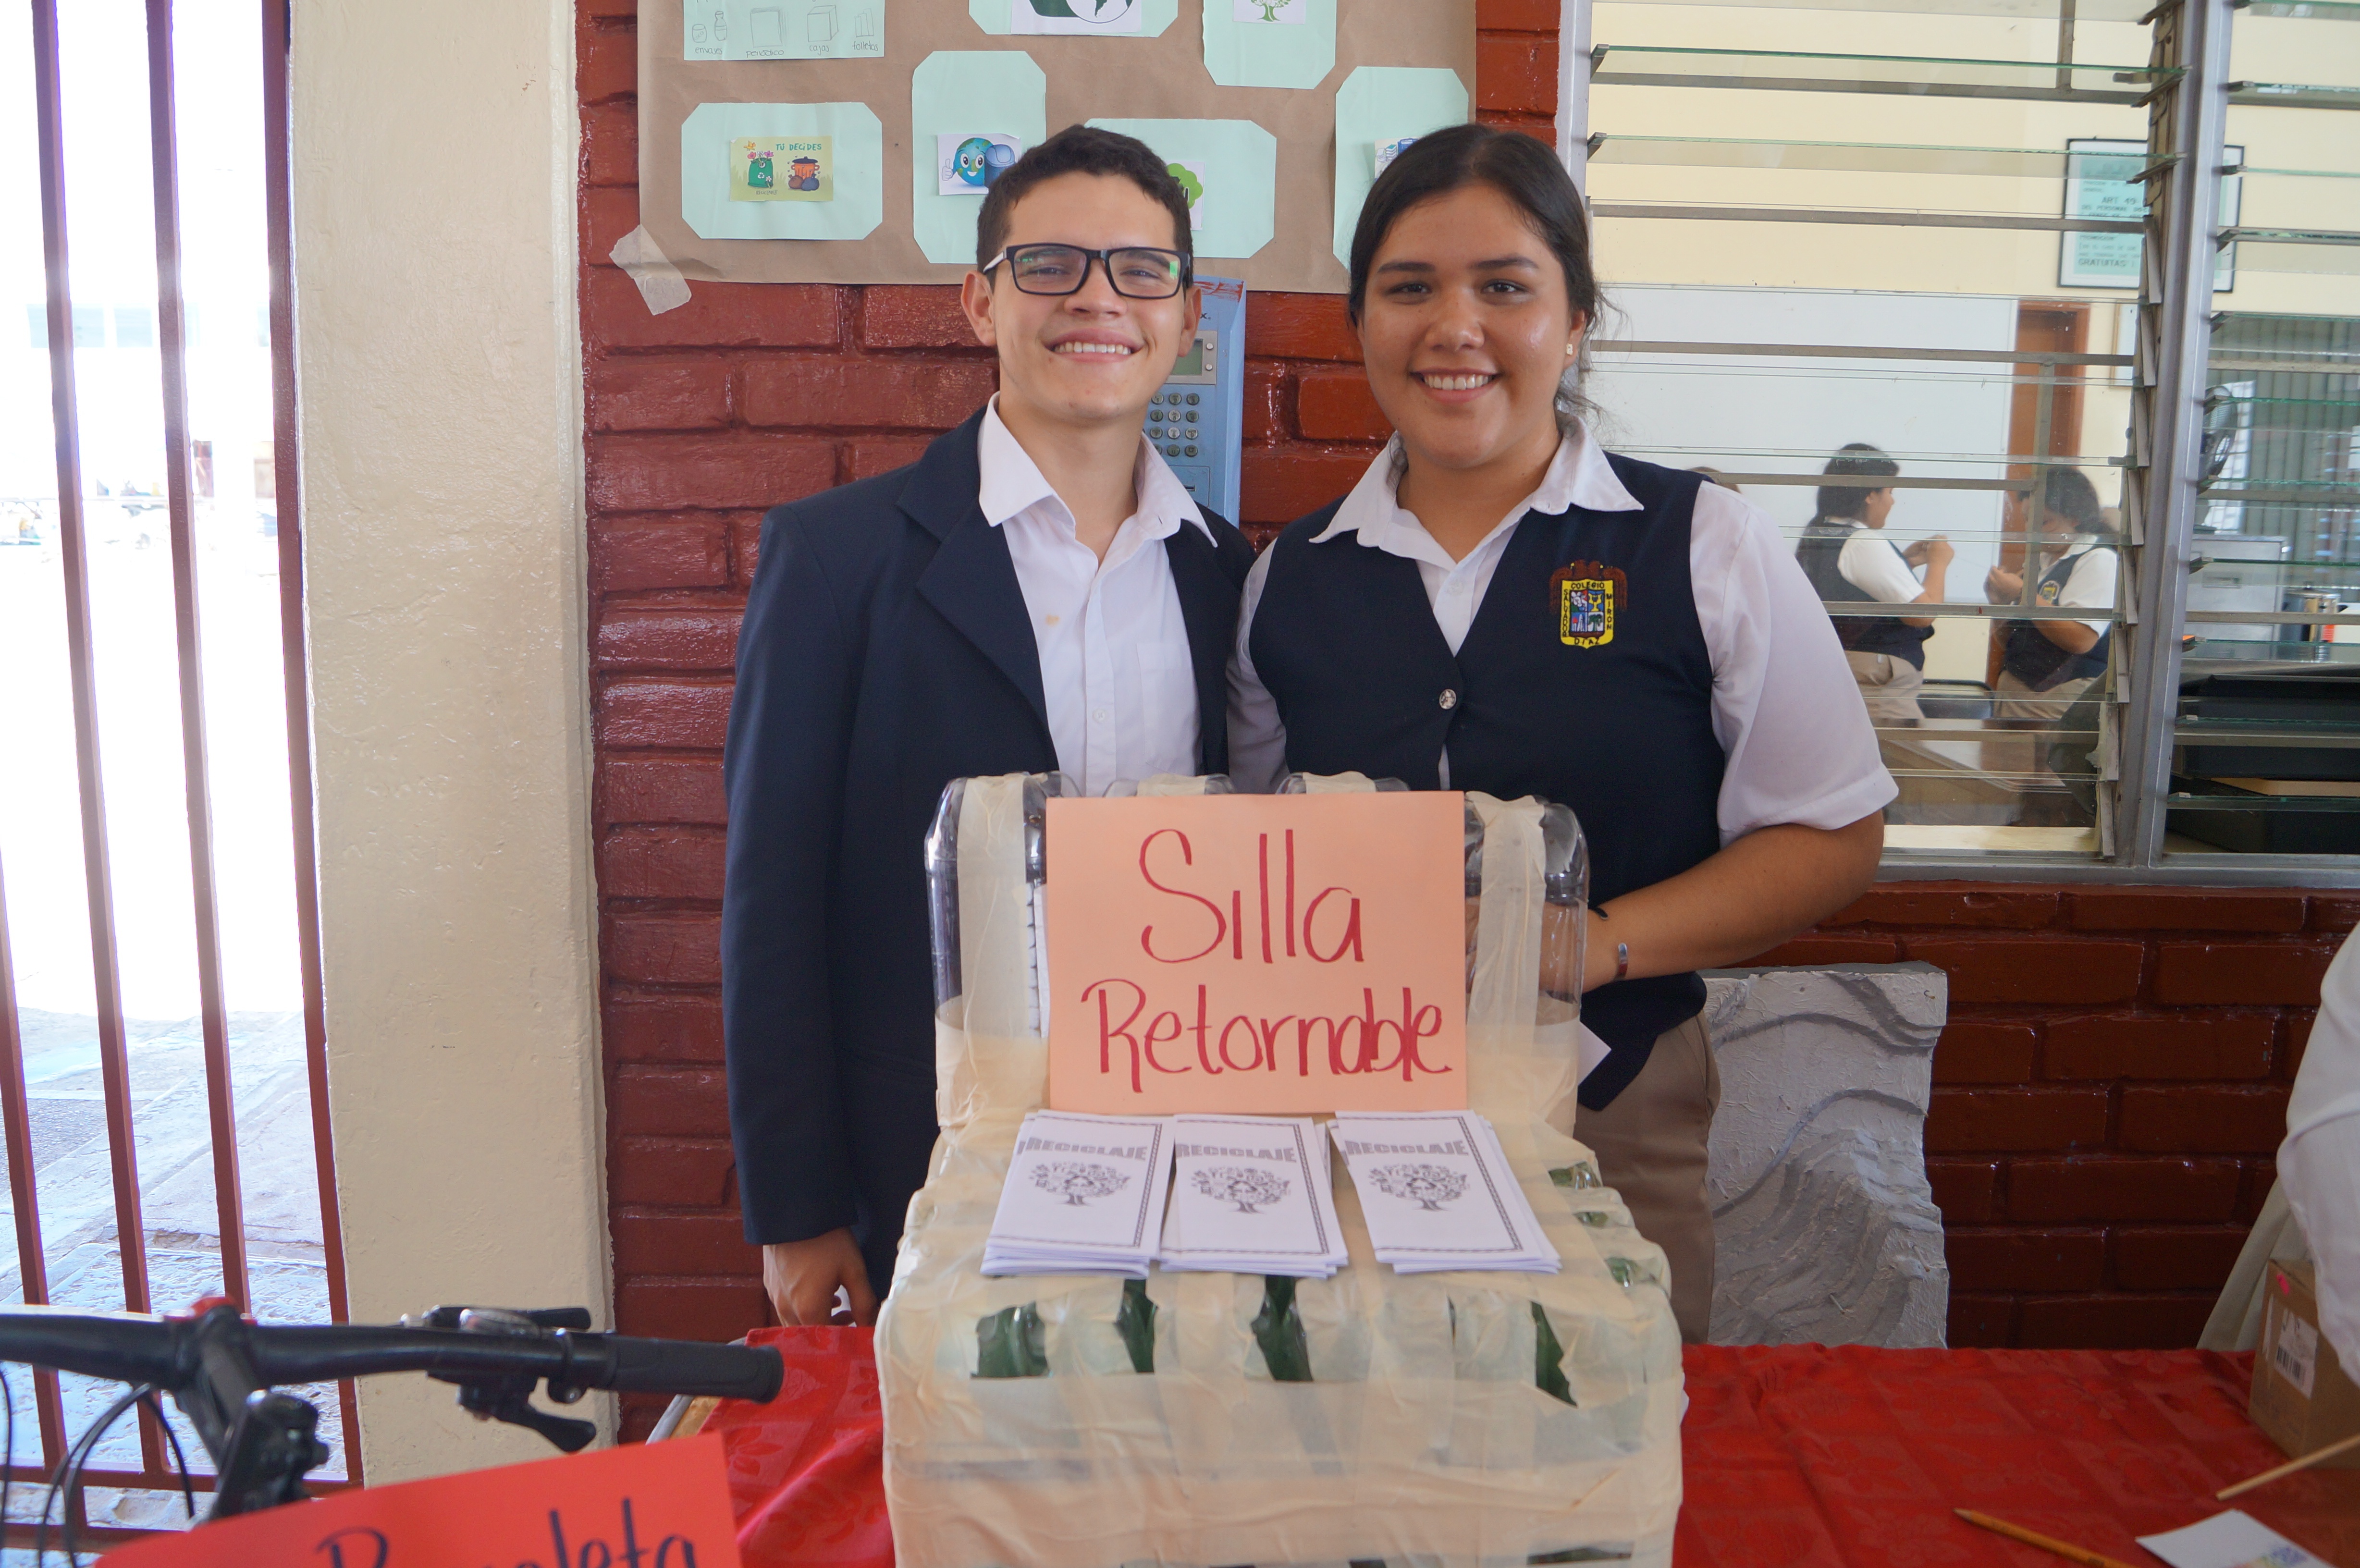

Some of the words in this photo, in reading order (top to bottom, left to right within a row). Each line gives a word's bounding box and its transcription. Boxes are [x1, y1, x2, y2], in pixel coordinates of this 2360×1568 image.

[809, 45, 830, 56] cajas
[852, 41, 879, 51] folletos
[1140, 829, 1364, 964] Silla
[1081, 979, 1453, 1093] Retornable
